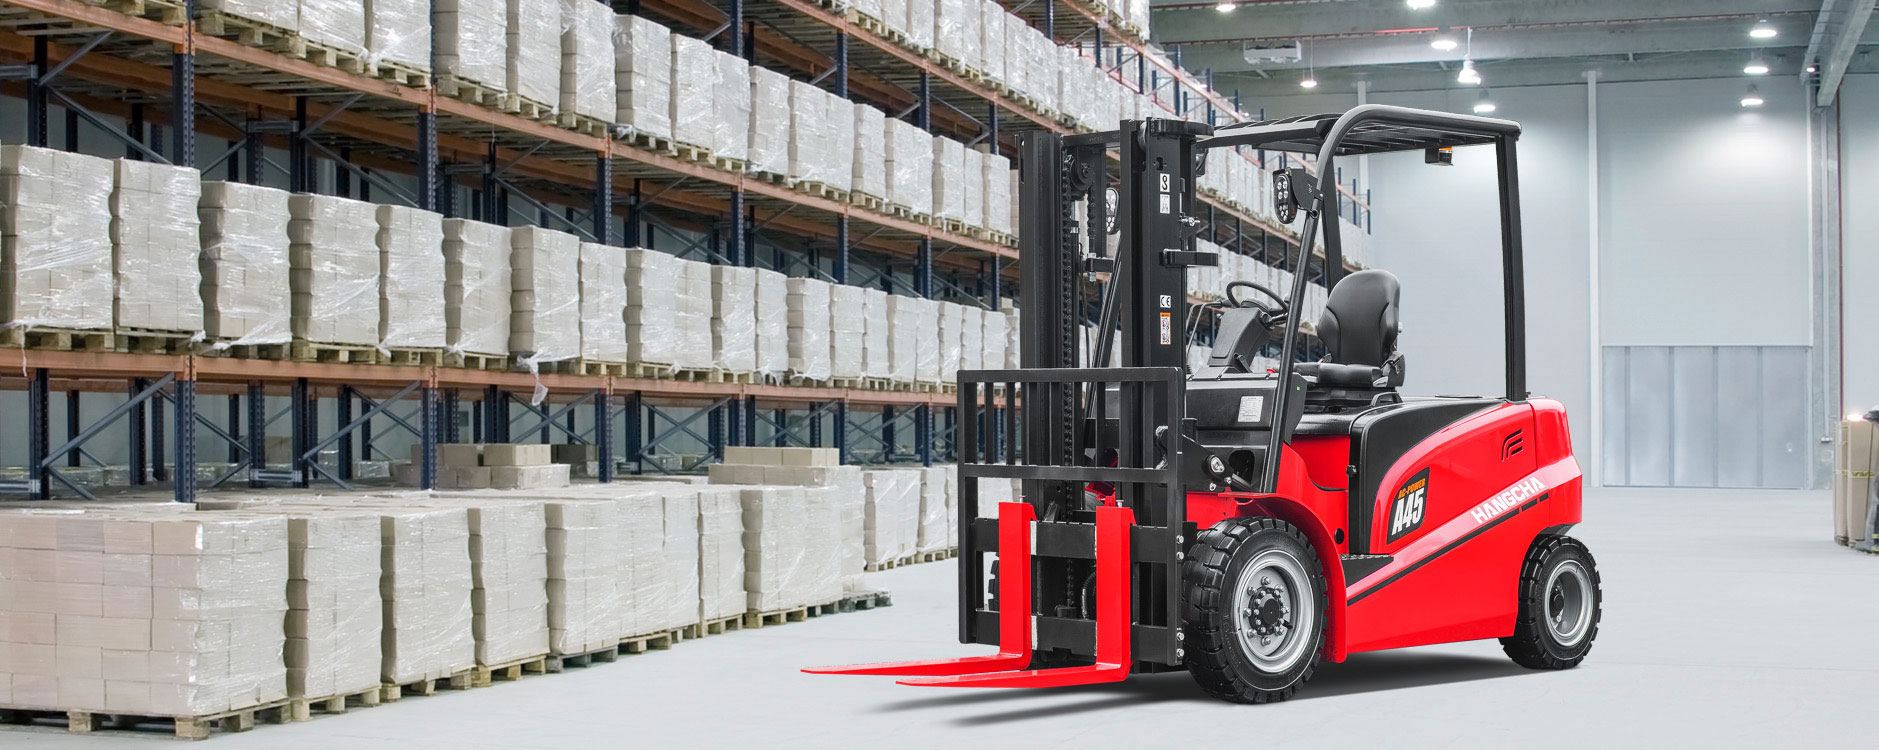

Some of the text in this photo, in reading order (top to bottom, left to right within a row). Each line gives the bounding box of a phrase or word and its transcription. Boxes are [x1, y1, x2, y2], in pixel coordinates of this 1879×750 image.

[1160, 296, 1171, 307] CE
[1398, 478, 1425, 499] AC-POWER
[1470, 476, 1546, 524] HANGCHA
[1391, 487, 1425, 536] A45
